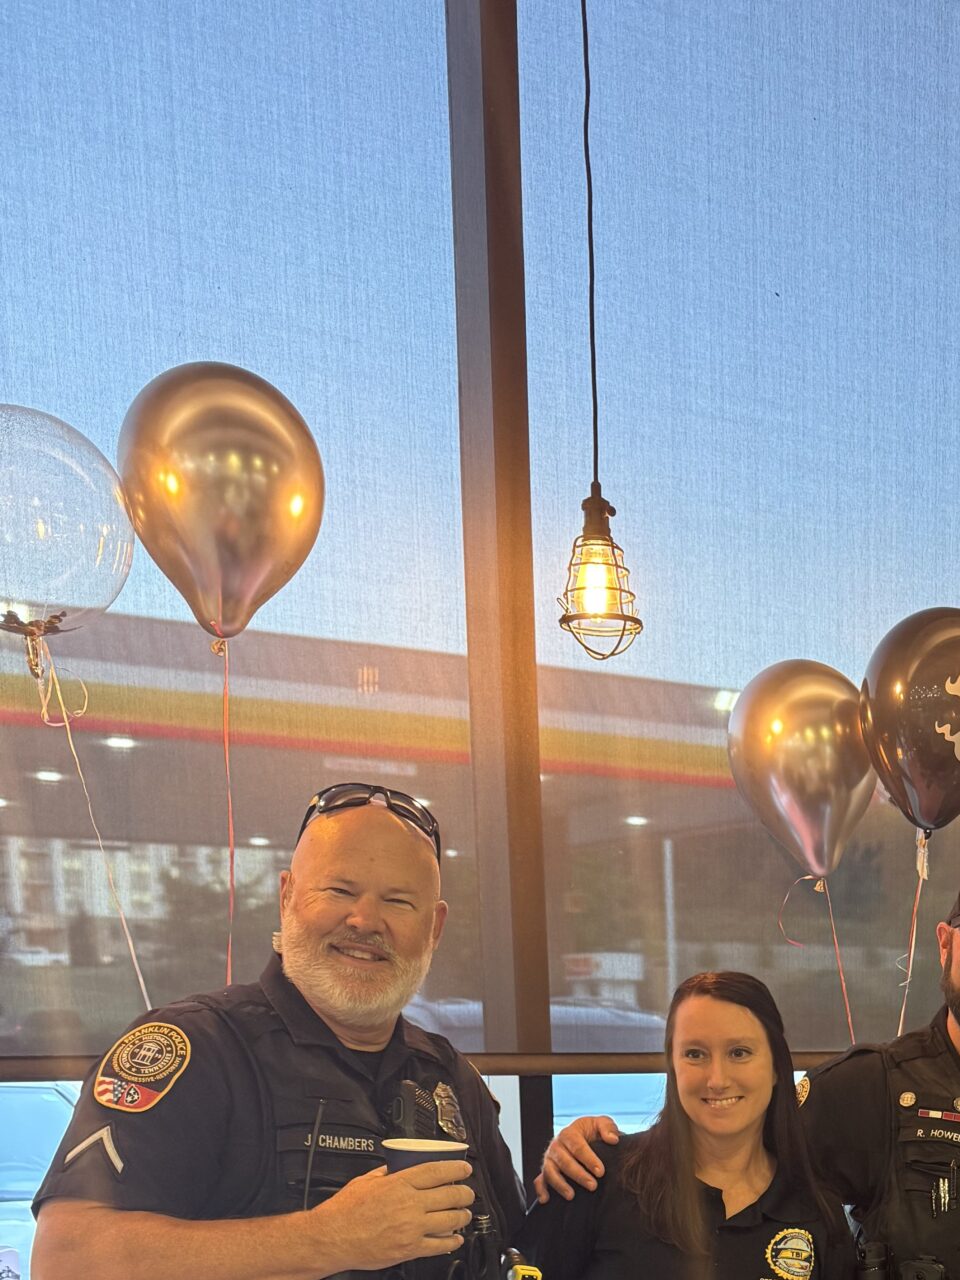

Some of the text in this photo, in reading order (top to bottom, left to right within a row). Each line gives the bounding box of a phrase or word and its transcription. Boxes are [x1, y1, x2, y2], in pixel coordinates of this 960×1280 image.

[123, 1026, 186, 1056] FRANKLIN POLICE
[916, 1129, 926, 1138] R.
[318, 1134, 375, 1152] CHAMBERS
[790, 1251, 803, 1259] TBI
